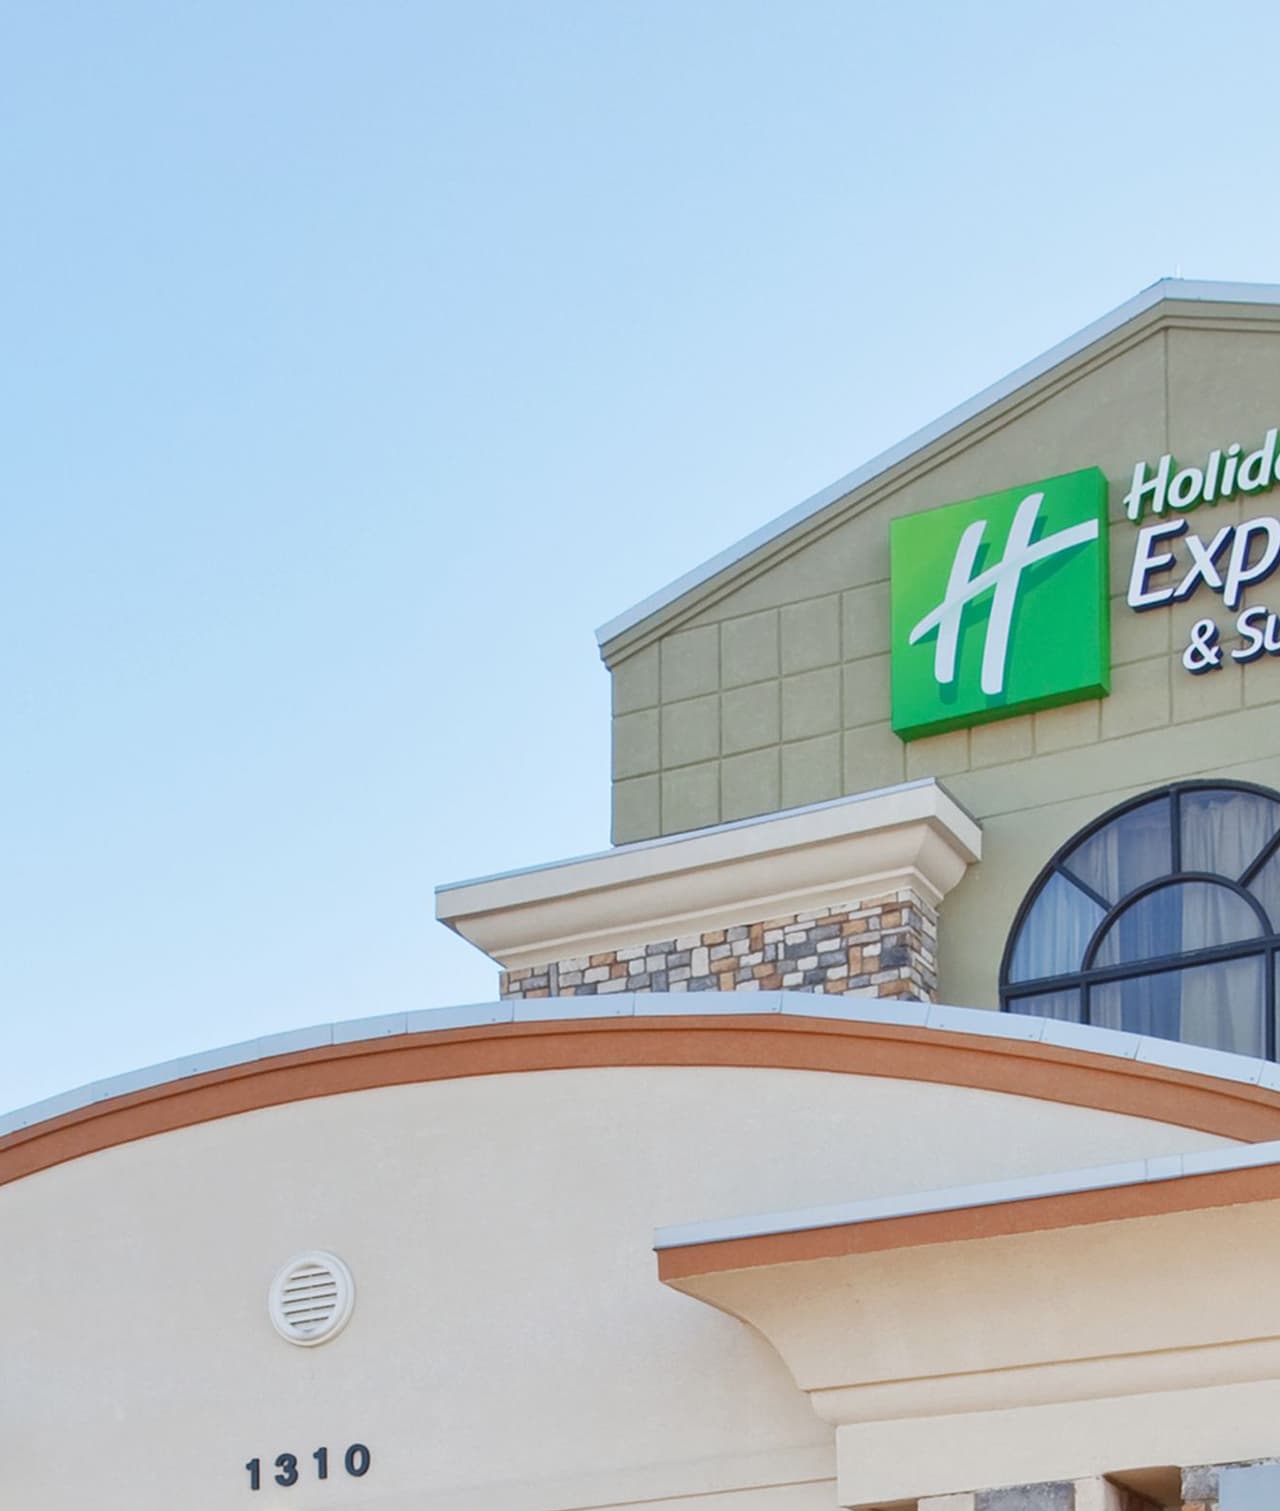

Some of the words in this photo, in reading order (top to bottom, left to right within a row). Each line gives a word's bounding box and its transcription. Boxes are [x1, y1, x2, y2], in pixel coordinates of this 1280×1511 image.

[908, 492, 1100, 696] H
[1182, 618, 1221, 673] &
[245, 1443, 371, 1491] 1310
